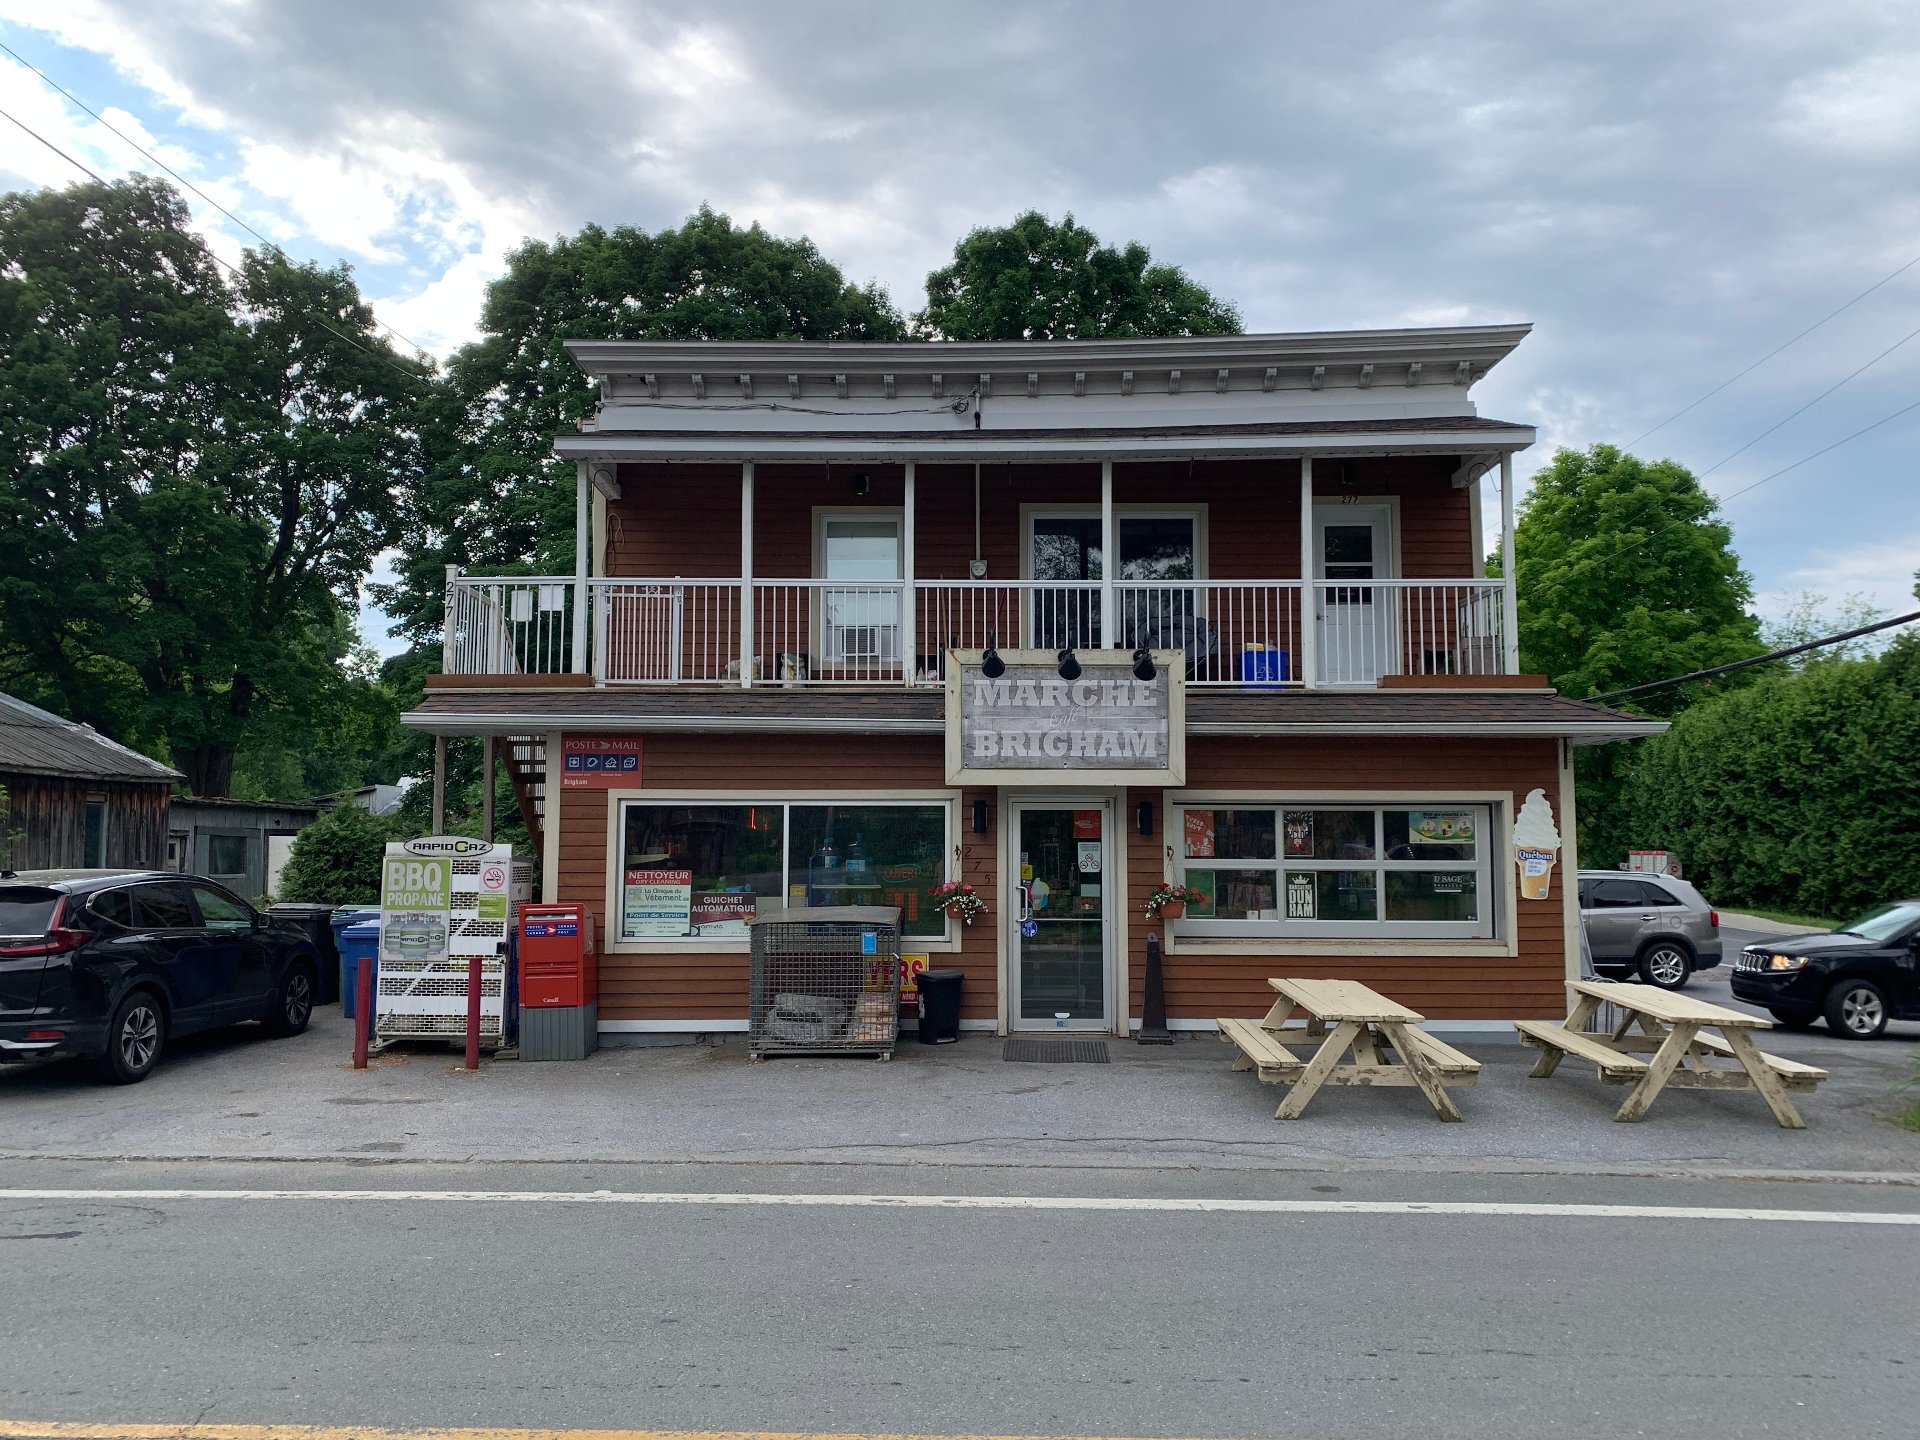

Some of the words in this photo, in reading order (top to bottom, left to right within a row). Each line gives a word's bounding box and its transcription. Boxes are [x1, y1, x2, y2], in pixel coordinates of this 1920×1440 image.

[1341, 495, 1359, 504] 277
[446, 581, 454, 618] 277
[973, 679, 1157, 707] MARCHE
[1049, 706, 1081, 728] Café
[565, 741, 597, 749] POSTE
[612, 741, 640, 750] MAIL
[973, 730, 1157, 757] BRIGHAM
[1519, 850, 1553, 860] Québon
[388, 862, 443, 892] BBQ
[628, 871, 689, 880] NETTOYEUR
[884, 868, 918, 879] OUVERT
[652, 887, 674, 895] Clinique
[1288, 889, 1313, 904] DUN
[386, 892, 445, 906] PROPANE
[703, 896, 744, 904] GUICHET
[691, 904, 755, 912] AUTOMATIQUE
[1289, 903, 1314, 918] HAM
